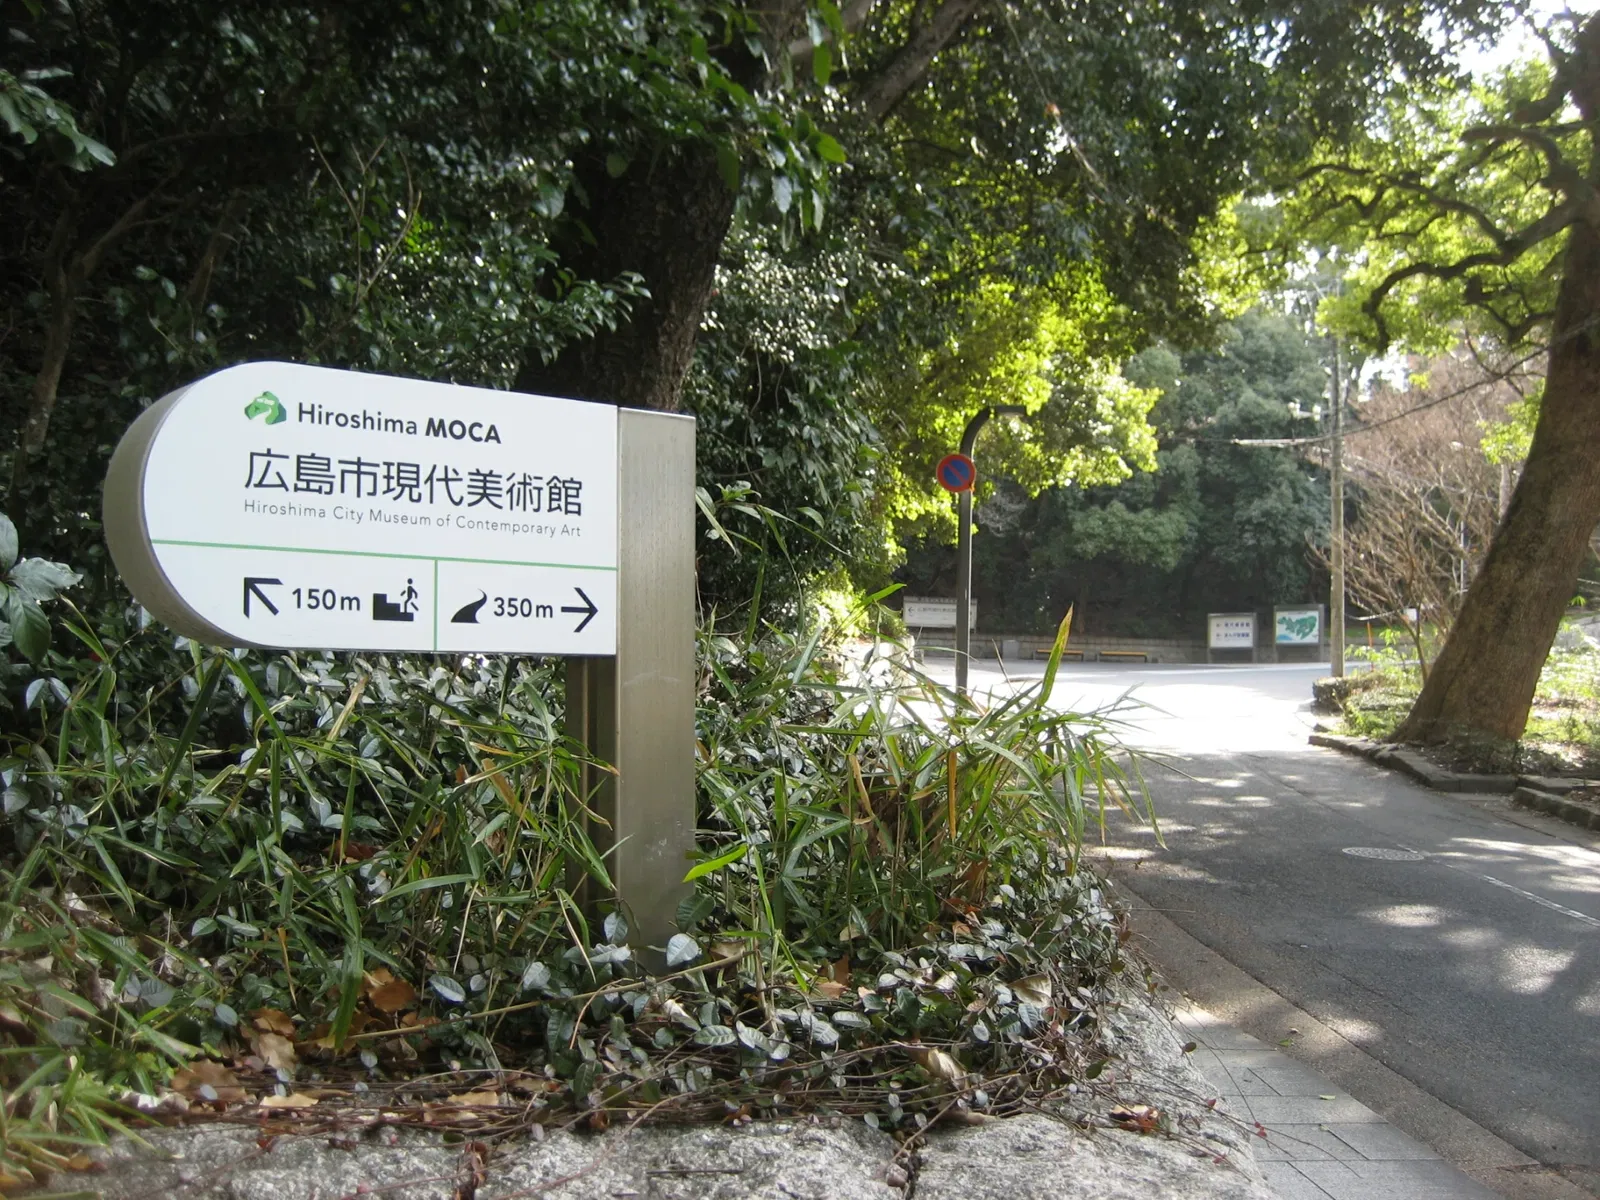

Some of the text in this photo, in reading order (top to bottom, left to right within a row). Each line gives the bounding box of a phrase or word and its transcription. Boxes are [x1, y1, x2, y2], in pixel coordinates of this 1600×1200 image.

[297, 401, 502, 444] Hiroshima MOCA
[244, 447, 583, 517] 広島市現代美術館
[244, 498, 581, 538] Hiroshima City Museum of Contemporary Art
[291, 587, 361, 611] 150m
[493, 596, 553, 618] 350m
